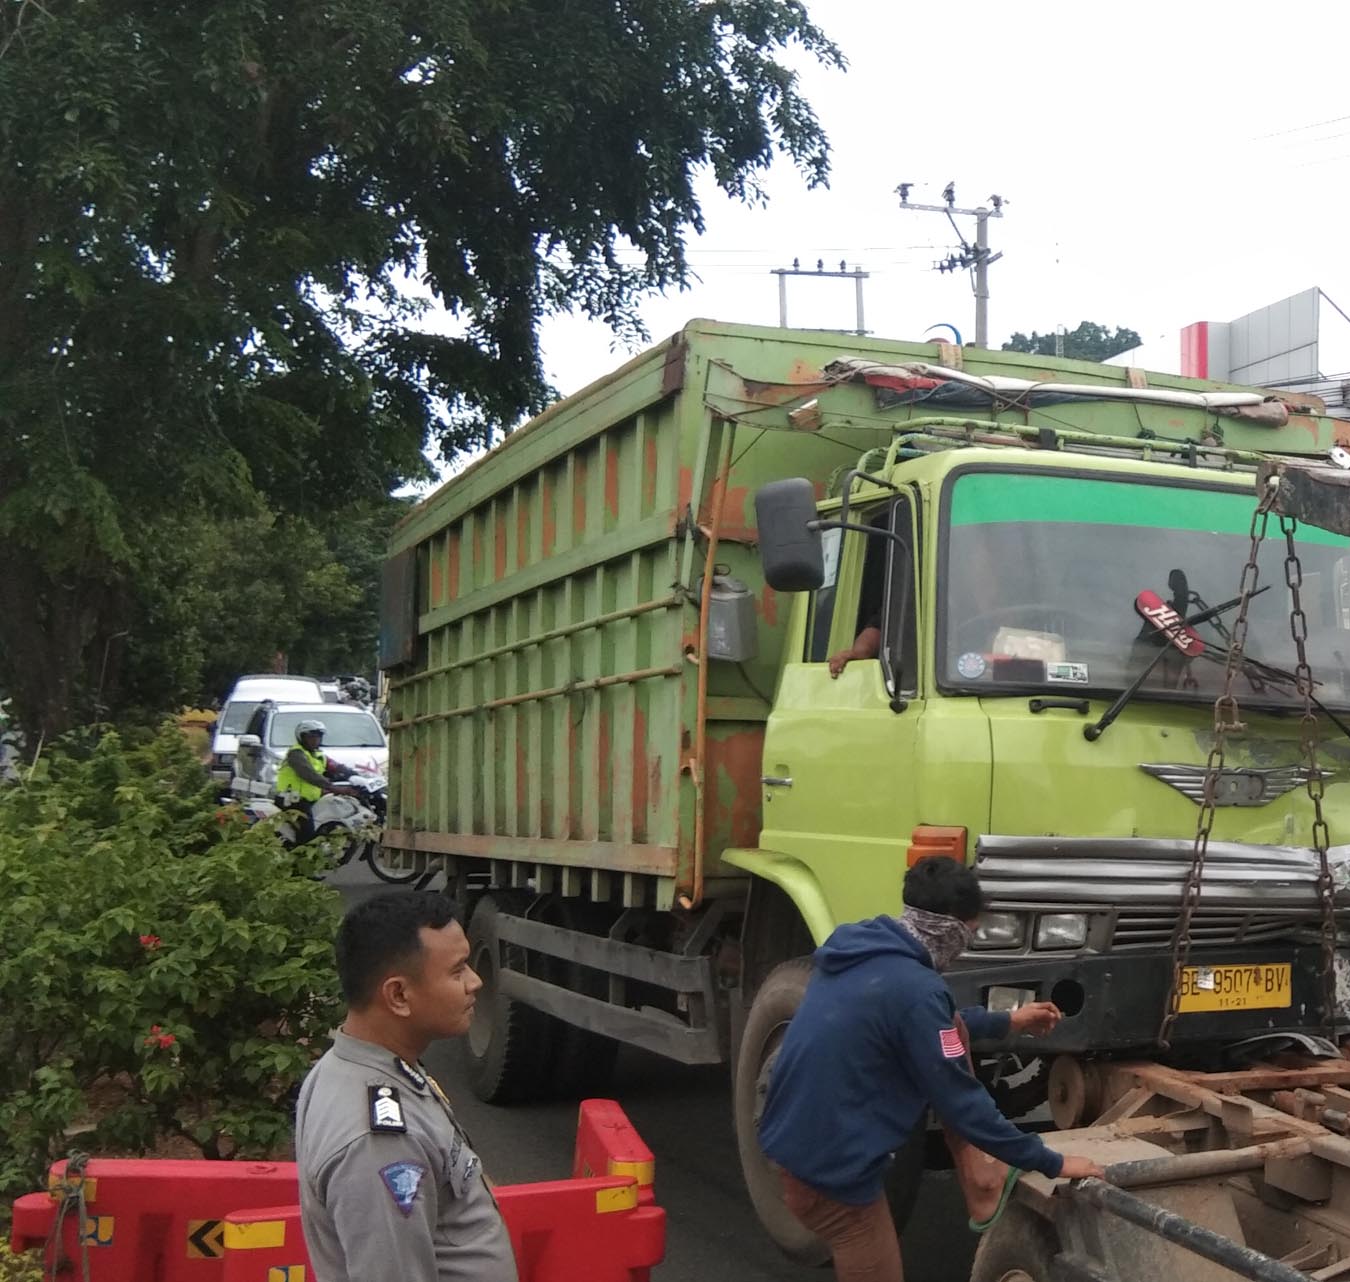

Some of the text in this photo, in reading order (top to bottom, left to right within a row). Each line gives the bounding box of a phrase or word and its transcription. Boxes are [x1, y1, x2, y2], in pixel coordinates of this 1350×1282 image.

[1213, 968, 1253, 995] 9507
[1264, 968, 1286, 992] BV
[1219, 997, 1247, 1007] 11-21
